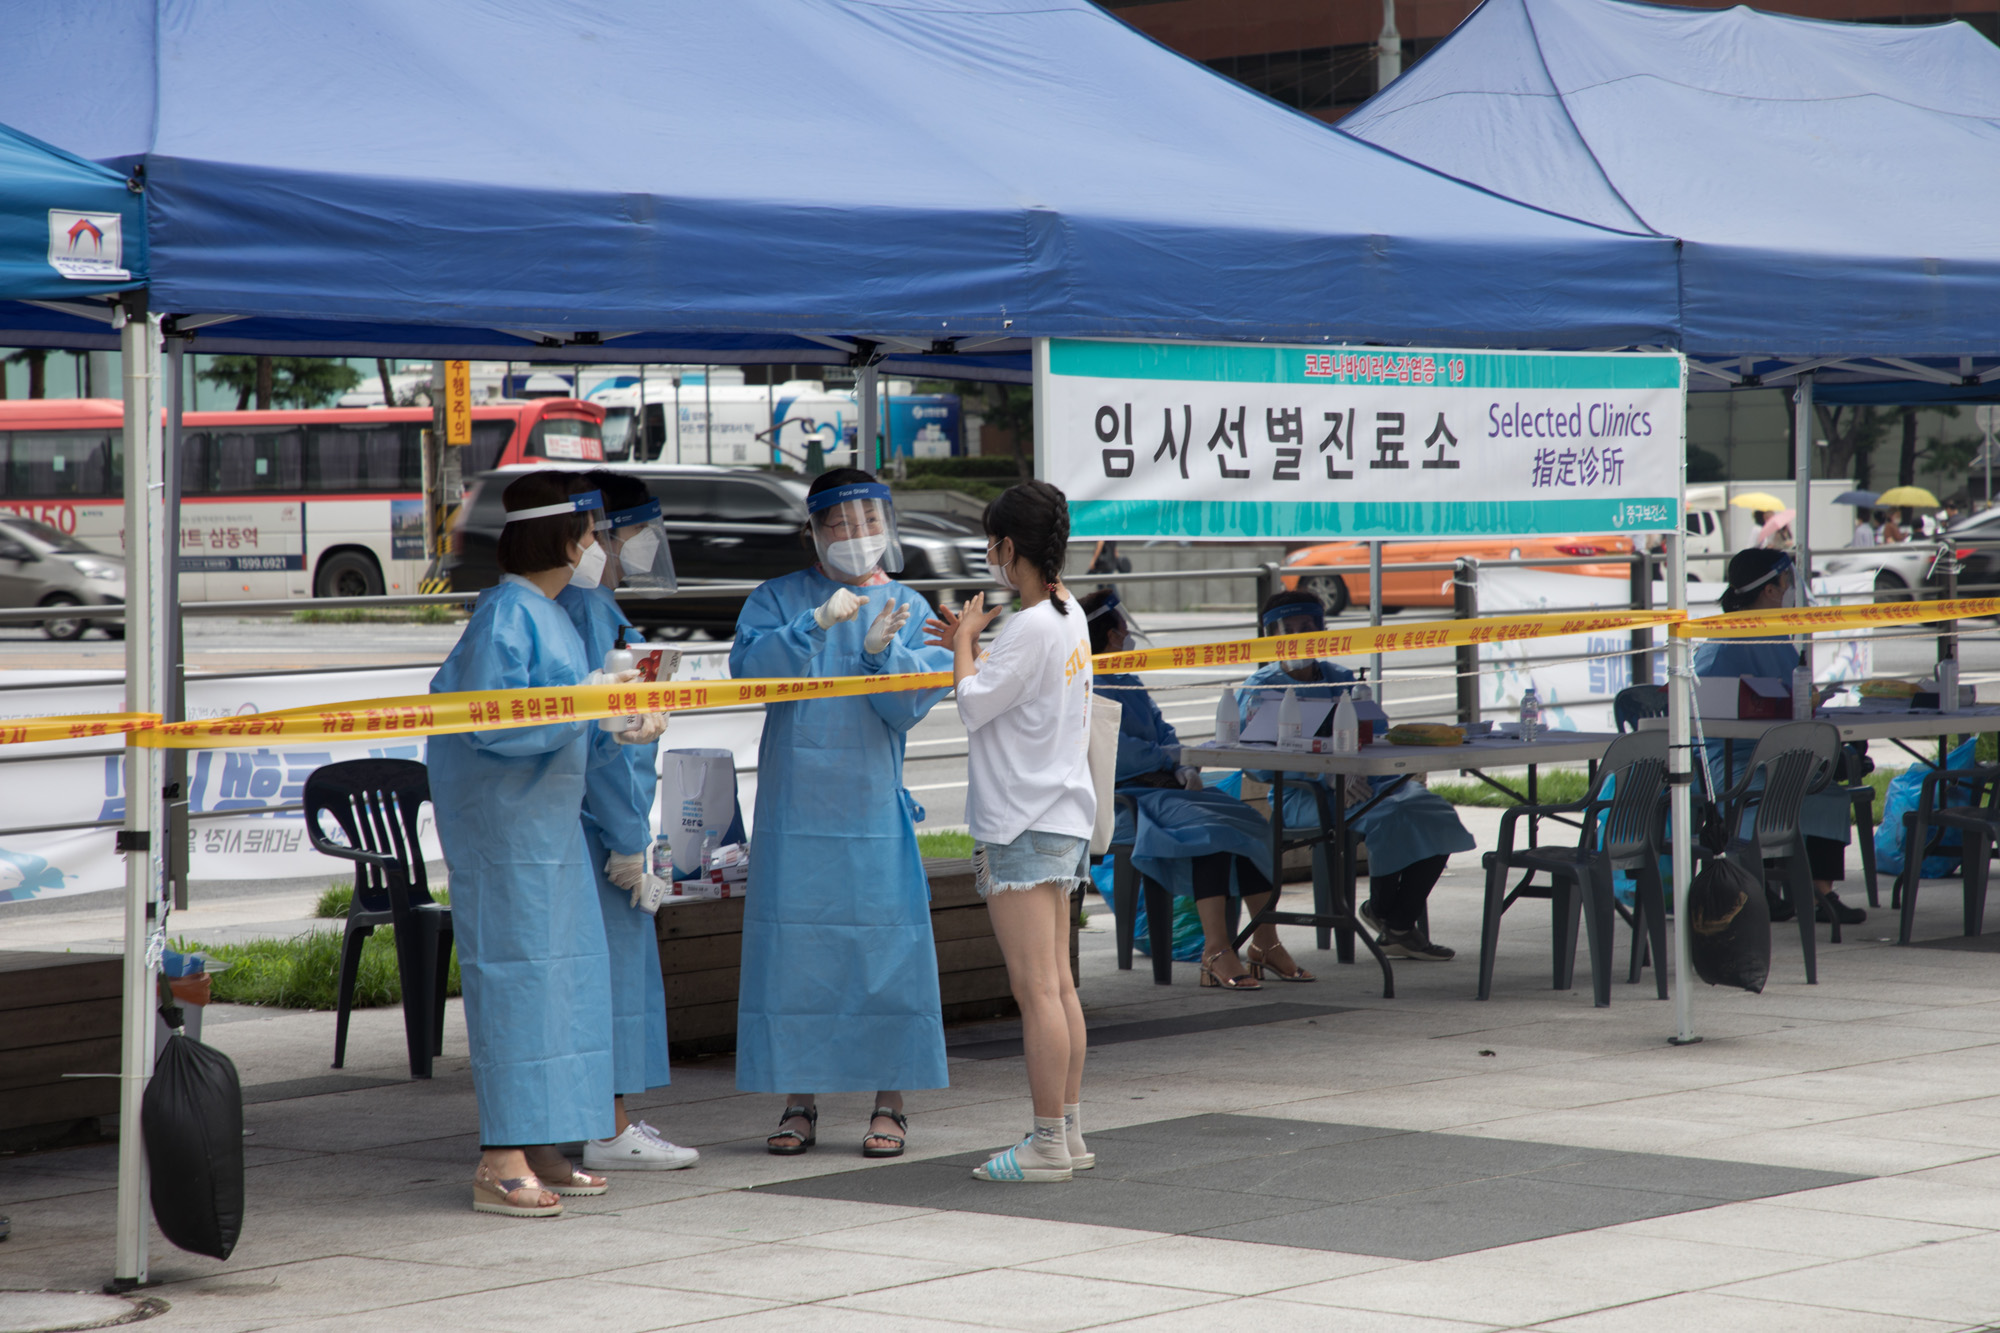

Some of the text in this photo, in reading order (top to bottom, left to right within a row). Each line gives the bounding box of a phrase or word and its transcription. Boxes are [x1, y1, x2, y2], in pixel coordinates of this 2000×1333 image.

[1304, 354, 1436, 383] 코로나바이러스감염증
[1448, 359, 1465, 382] 19
[1488, 402, 1652, 438] Selected Clinics
[1094, 402, 1462, 482] 임시선별진료소
[1532, 446, 1624, 488] 指定诊所
[1626, 504, 1668, 525] 중구보건소
[208, 527, 258, 549] 삼동역
[237, 557, 287, 569] 1599.6921
[1374, 629, 1450, 651] 위험 출입금지
[1469, 622, 1543, 642] 위험 출입금지
[1172, 642, 1251, 666] 위험 출입금지
[1275, 635, 1352, 659] 위험 출입금지
[468, 696, 576, 726] 위험 출입금지
[608, 688, 708, 716] 위험 출입금지
[320, 704, 434, 733] 위험 출입금지
